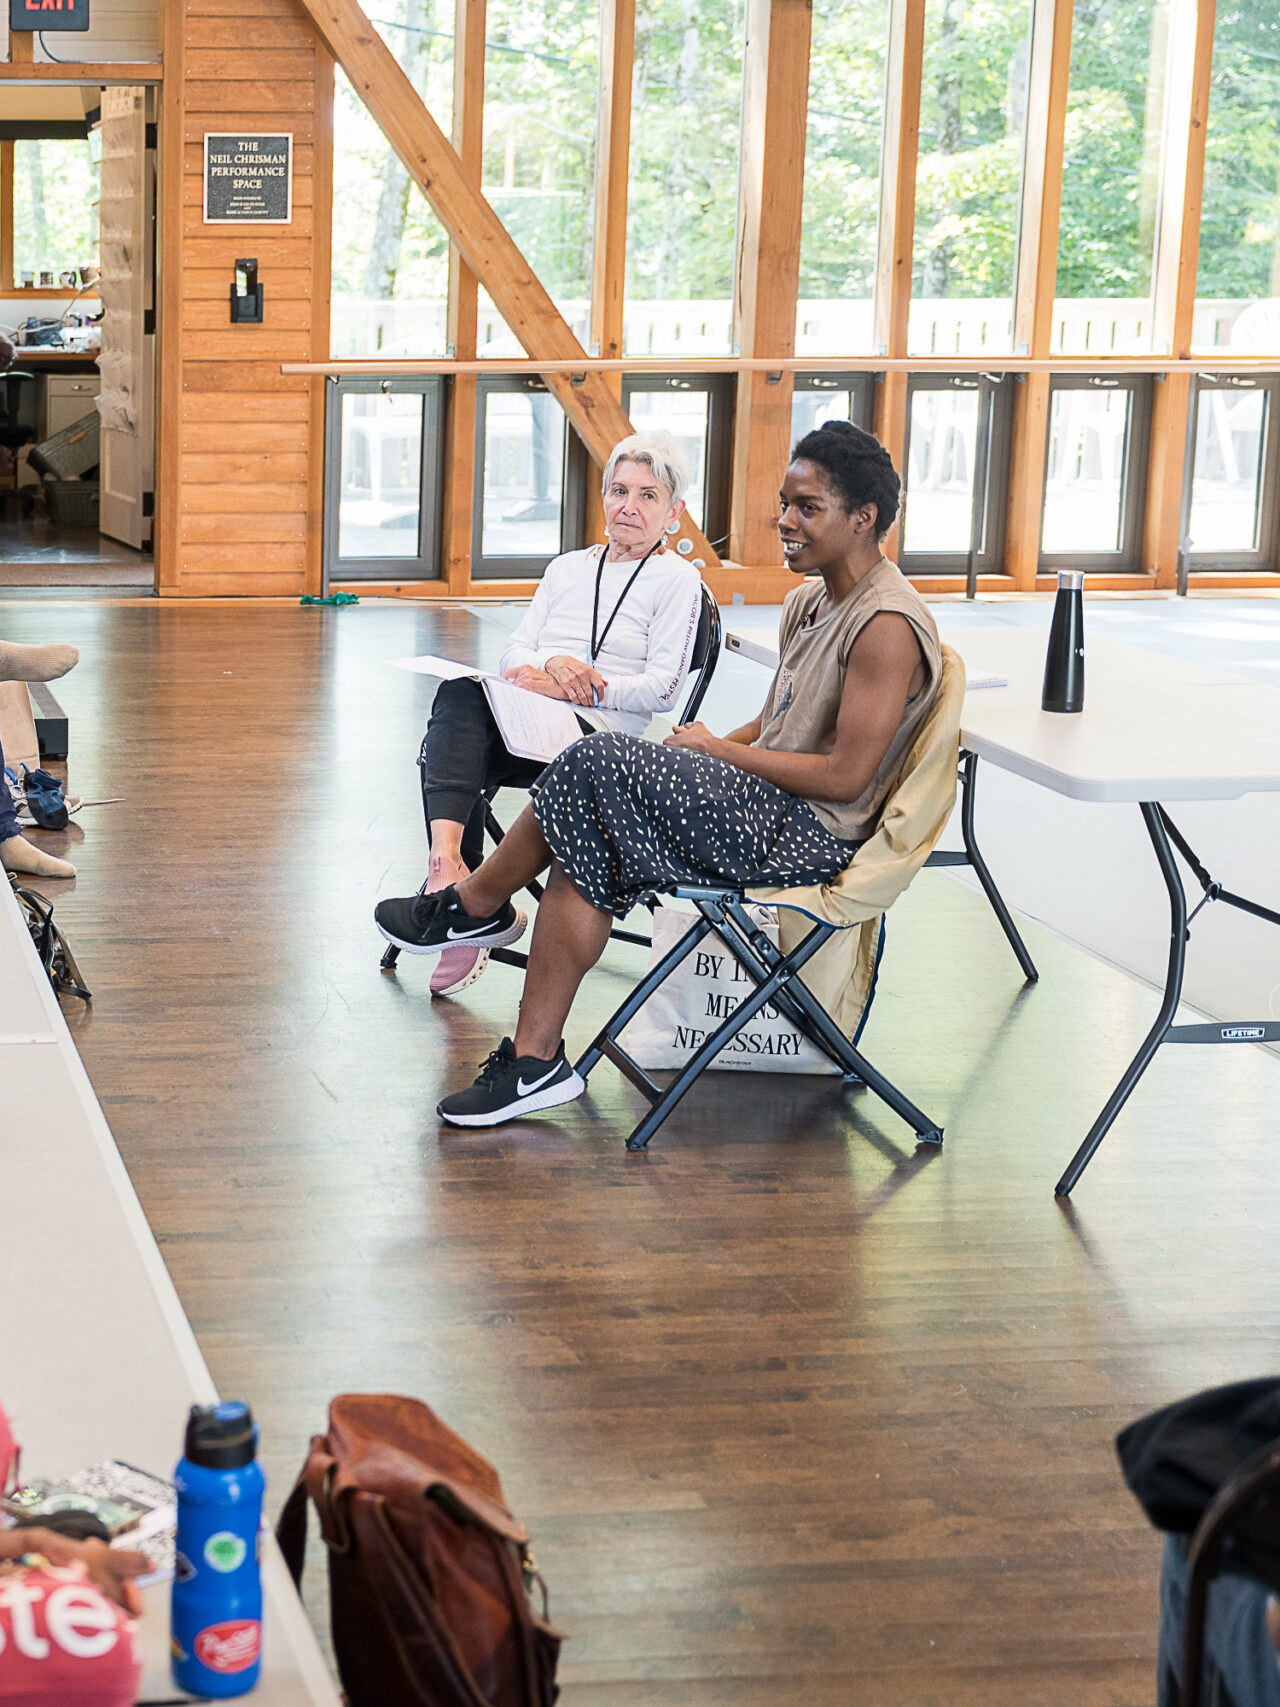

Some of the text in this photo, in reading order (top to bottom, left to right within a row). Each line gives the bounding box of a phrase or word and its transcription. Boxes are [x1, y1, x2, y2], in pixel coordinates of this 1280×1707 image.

[237, 142, 259, 152] THE
[210, 154, 287, 164] NEIL CHRISMAN
[211, 167, 285, 176] PERFORMANCE
[233, 179, 263, 189] SPACE
[694, 951, 725, 980] BY
[672, 1025, 805, 1056] NESSARY
